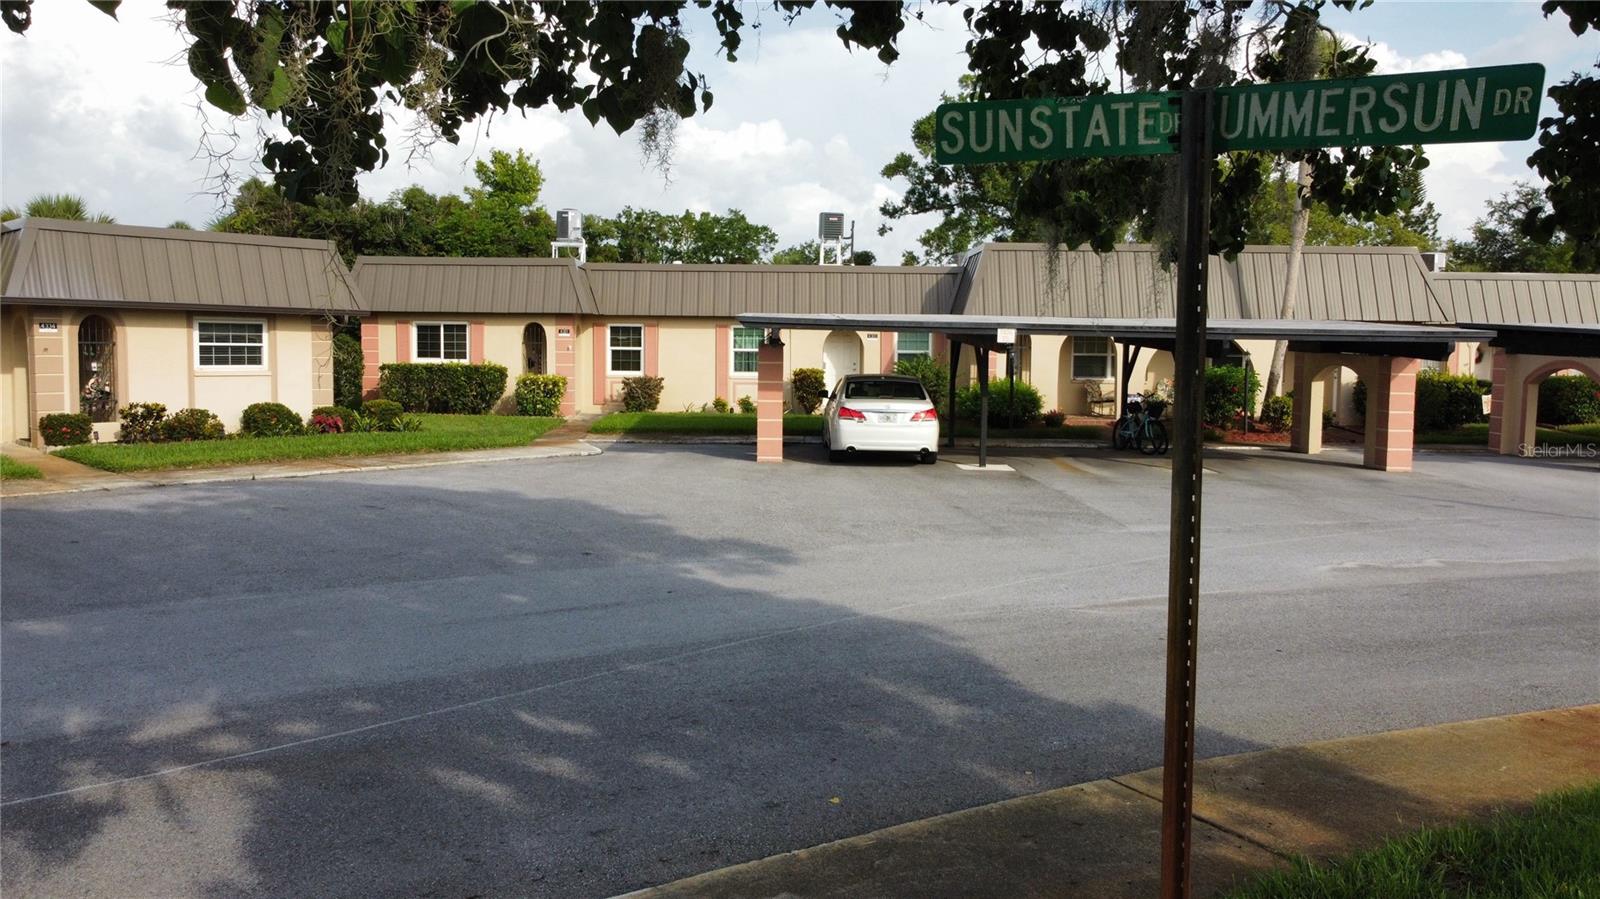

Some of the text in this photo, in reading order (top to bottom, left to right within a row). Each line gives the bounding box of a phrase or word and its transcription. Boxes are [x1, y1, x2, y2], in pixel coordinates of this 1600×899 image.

[940, 101, 1161, 154] SUNSTATE
[1219, 77, 1534, 140] UMMERSUN DR
